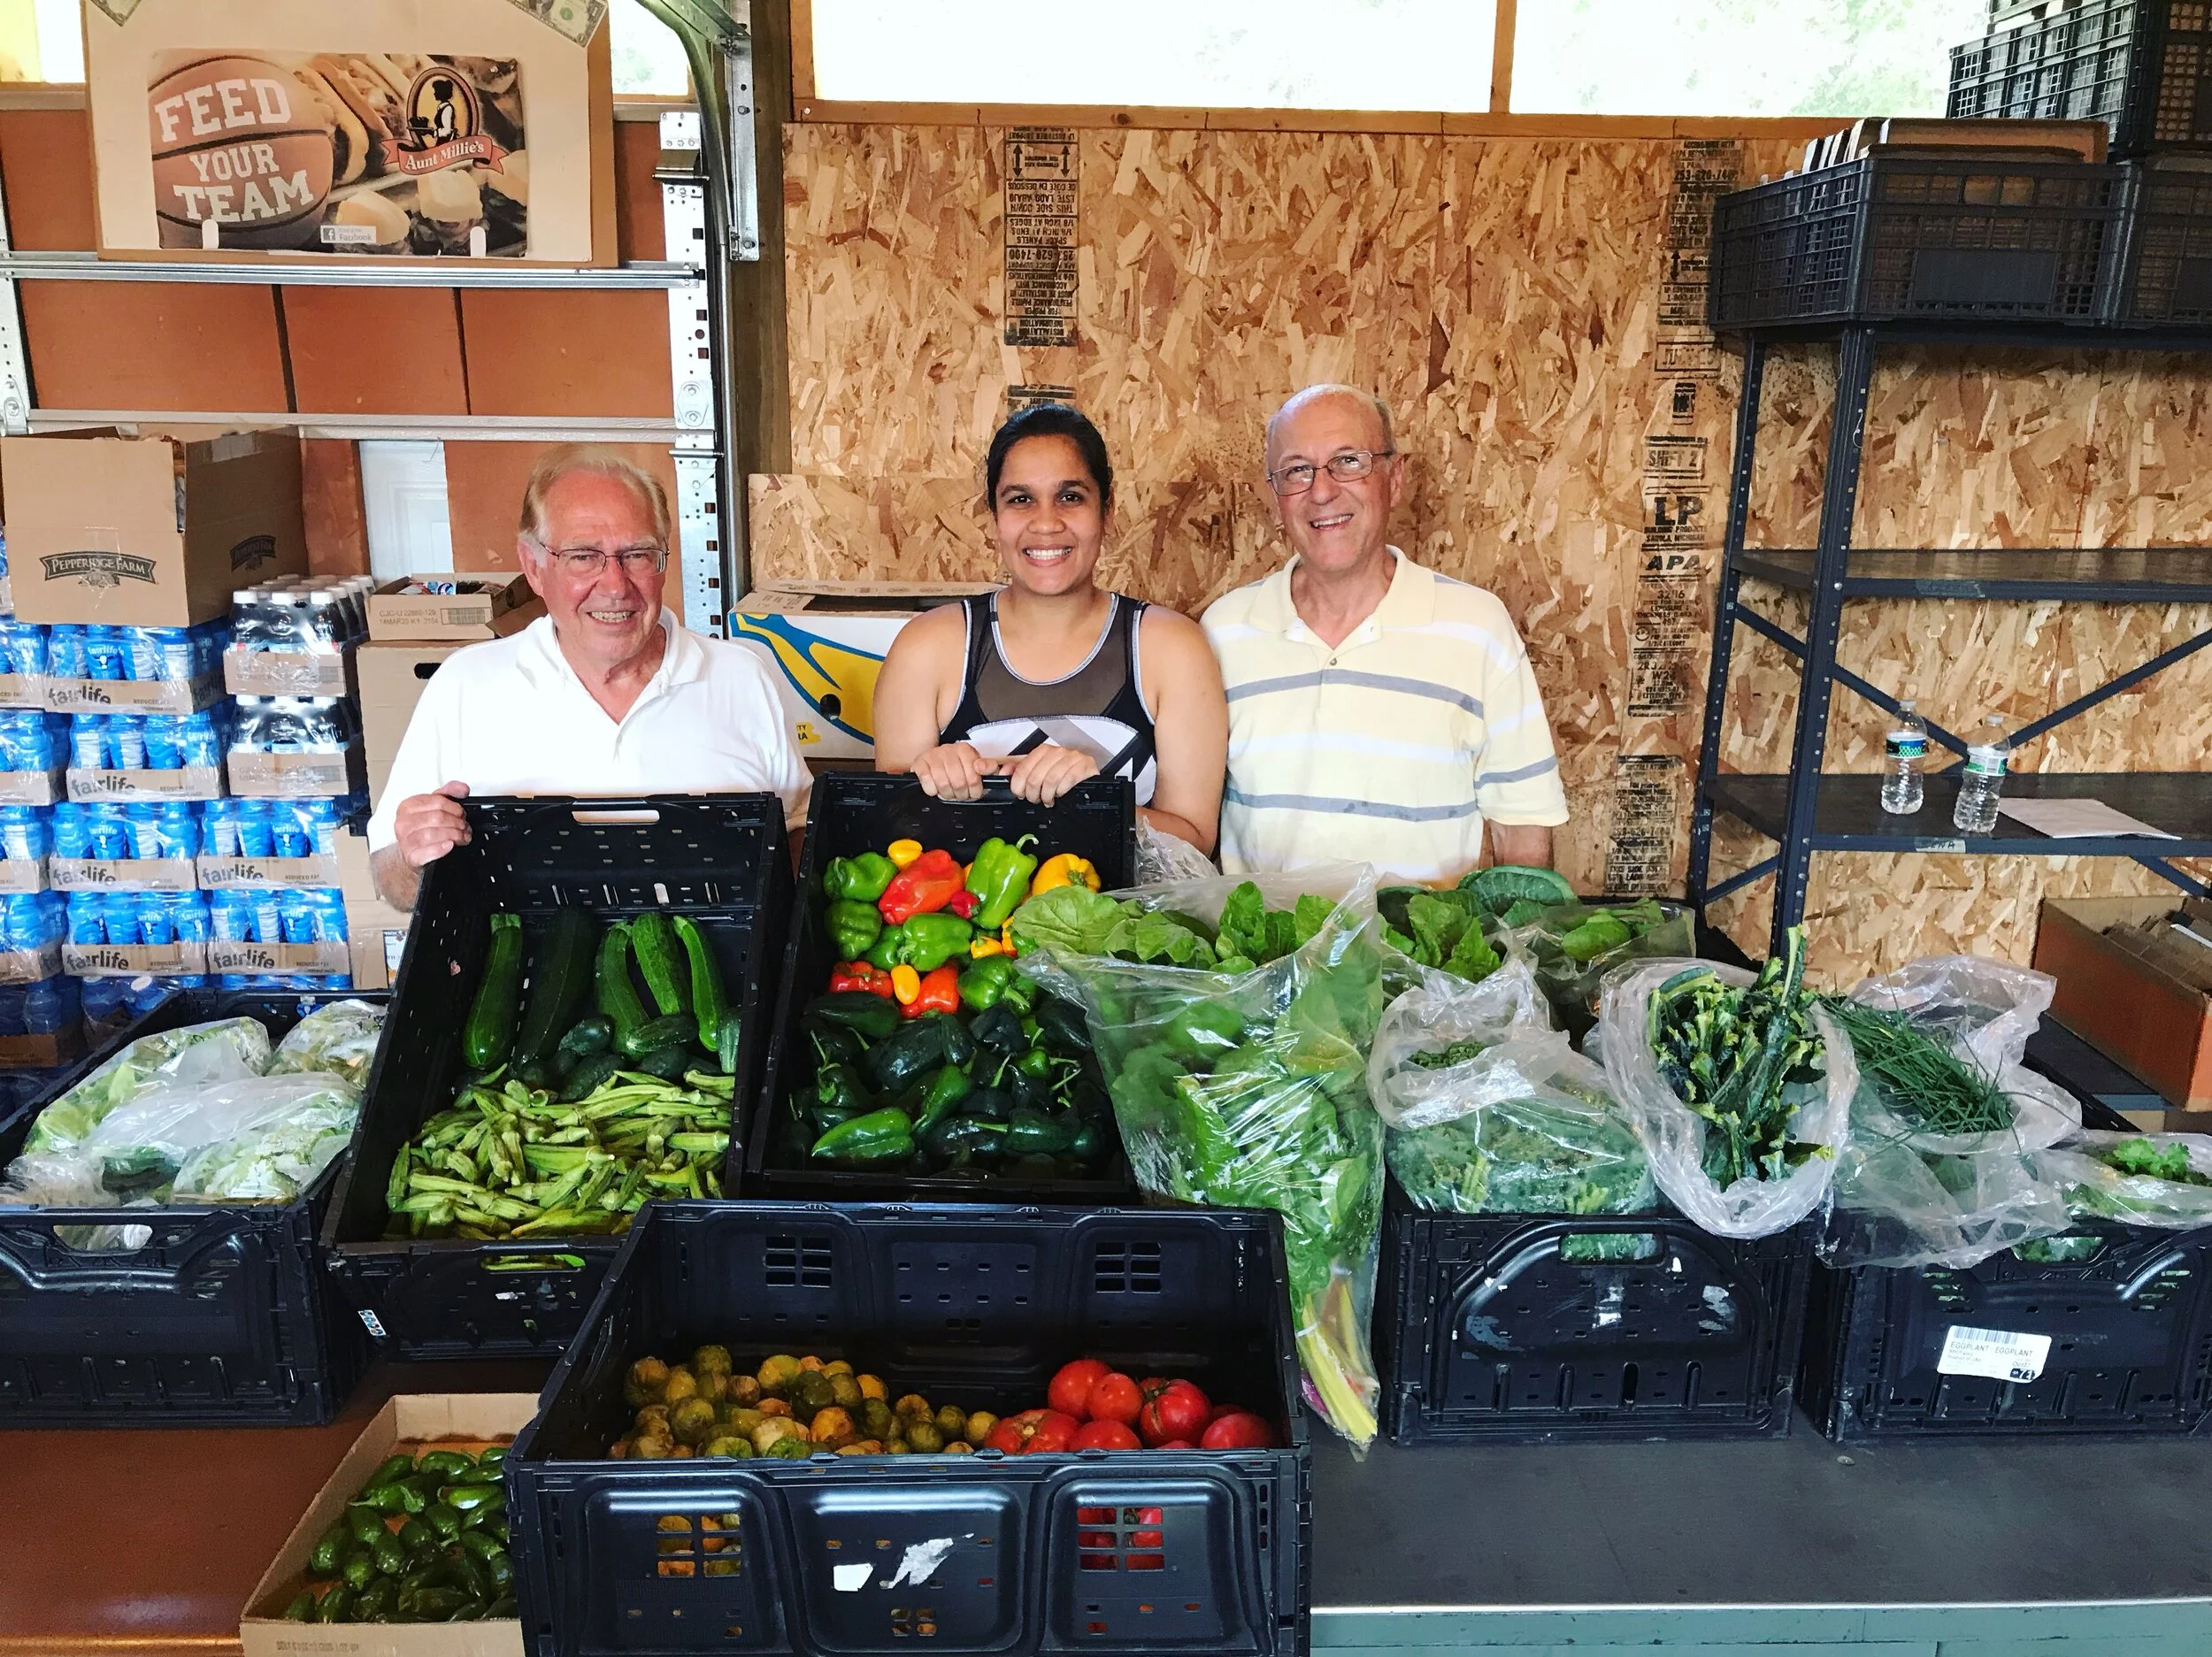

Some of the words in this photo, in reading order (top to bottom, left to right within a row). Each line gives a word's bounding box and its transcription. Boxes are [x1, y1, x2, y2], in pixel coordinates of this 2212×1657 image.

[155, 78, 291, 142] FEED
[189, 142, 280, 182] YOUR
[405, 154, 437, 171] Aunt
[441, 142, 484, 162] Millie's
[173, 169, 314, 224] TEAM
[1036, 203, 1053, 212] SIDE
[1689, 449, 1697, 467] 2
[1654, 496, 1703, 525] LP
[51, 557, 114, 571] PEPPERIDGE
[116, 558, 145, 575] FARM
[1645, 555, 1701, 570] APA
[49, 686, 111, 706] fairlife
[72, 777, 135, 796] fairlife
[53, 866, 116, 886] fairlife
[203, 864, 264, 885] fairlife
[66, 950, 129, 970] fairlife
[214, 949, 275, 970] fairlife
[1950, 1341, 1989, 1351] EGGPLANT
[1994, 1346, 2034, 1357] EGGPLANT
